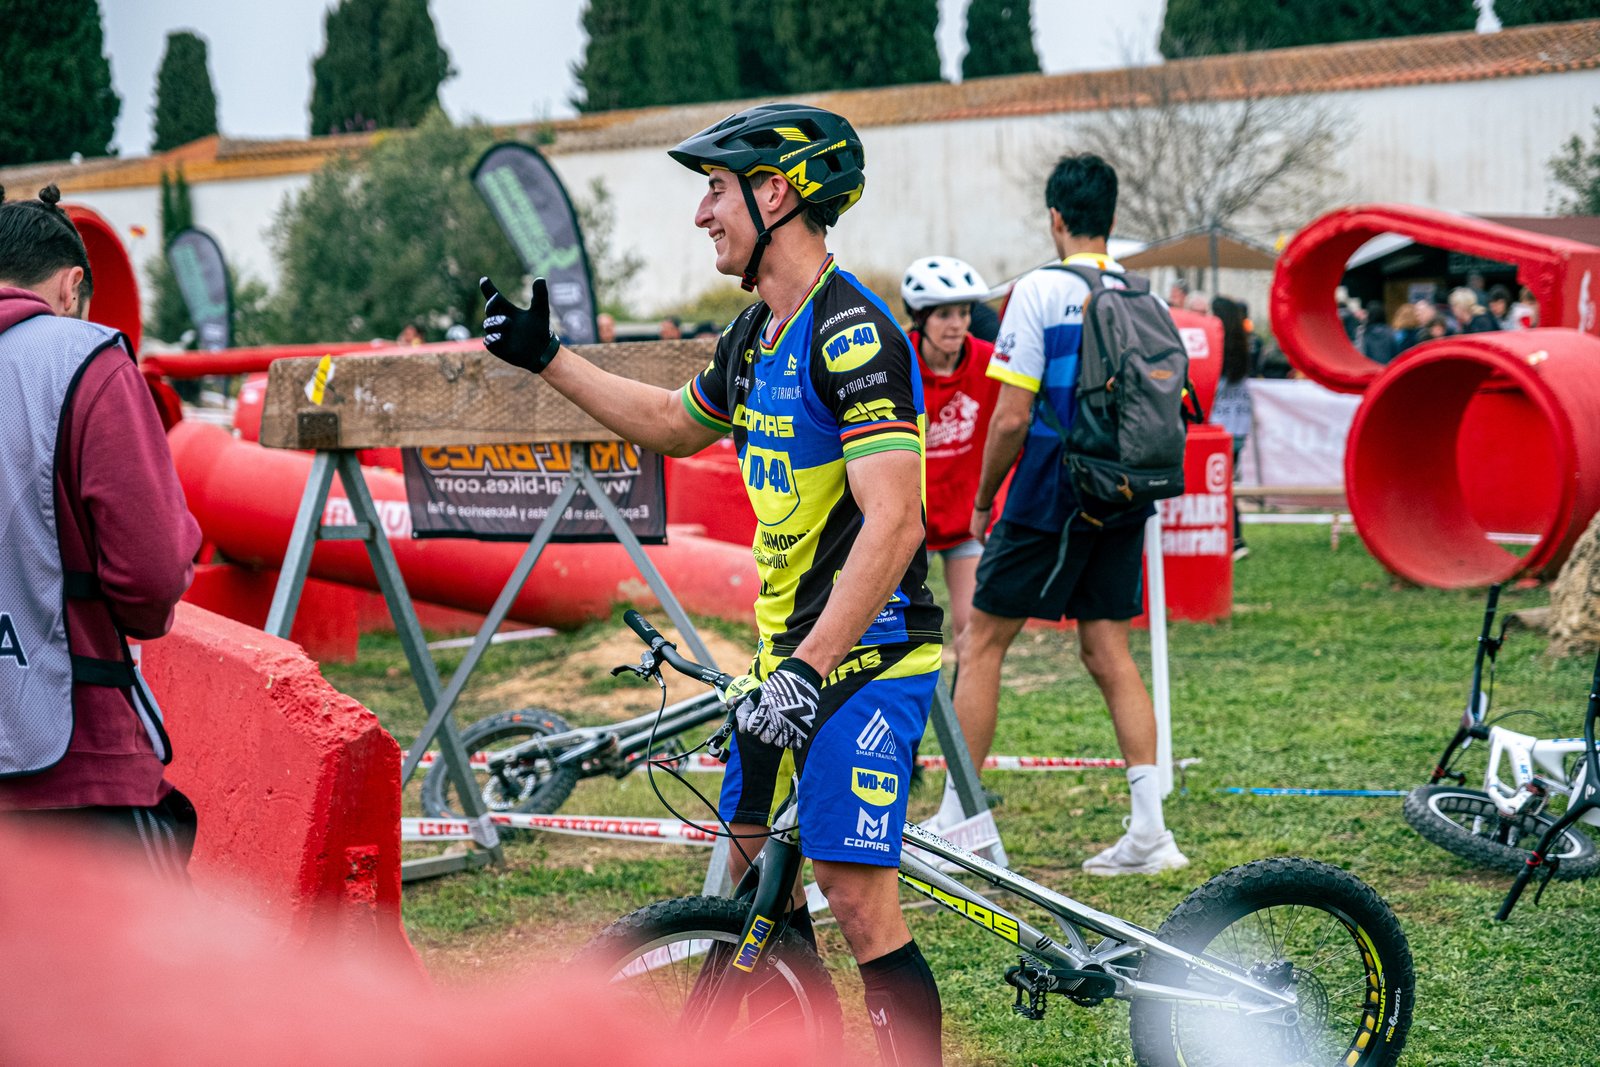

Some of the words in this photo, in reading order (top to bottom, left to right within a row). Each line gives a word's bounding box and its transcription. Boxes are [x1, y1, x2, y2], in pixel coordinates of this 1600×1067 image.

[820, 306, 867, 335] MUCHMORE
[825, 326, 877, 362] WD-40
[846, 371, 888, 395] TRIALSPORT
[732, 403, 795, 438] COMAS
[855, 749, 875, 757] SMART
[856, 771, 896, 794] WD-40
[843, 837, 890, 852] COMAS
[736, 918, 772, 969] WD-40
